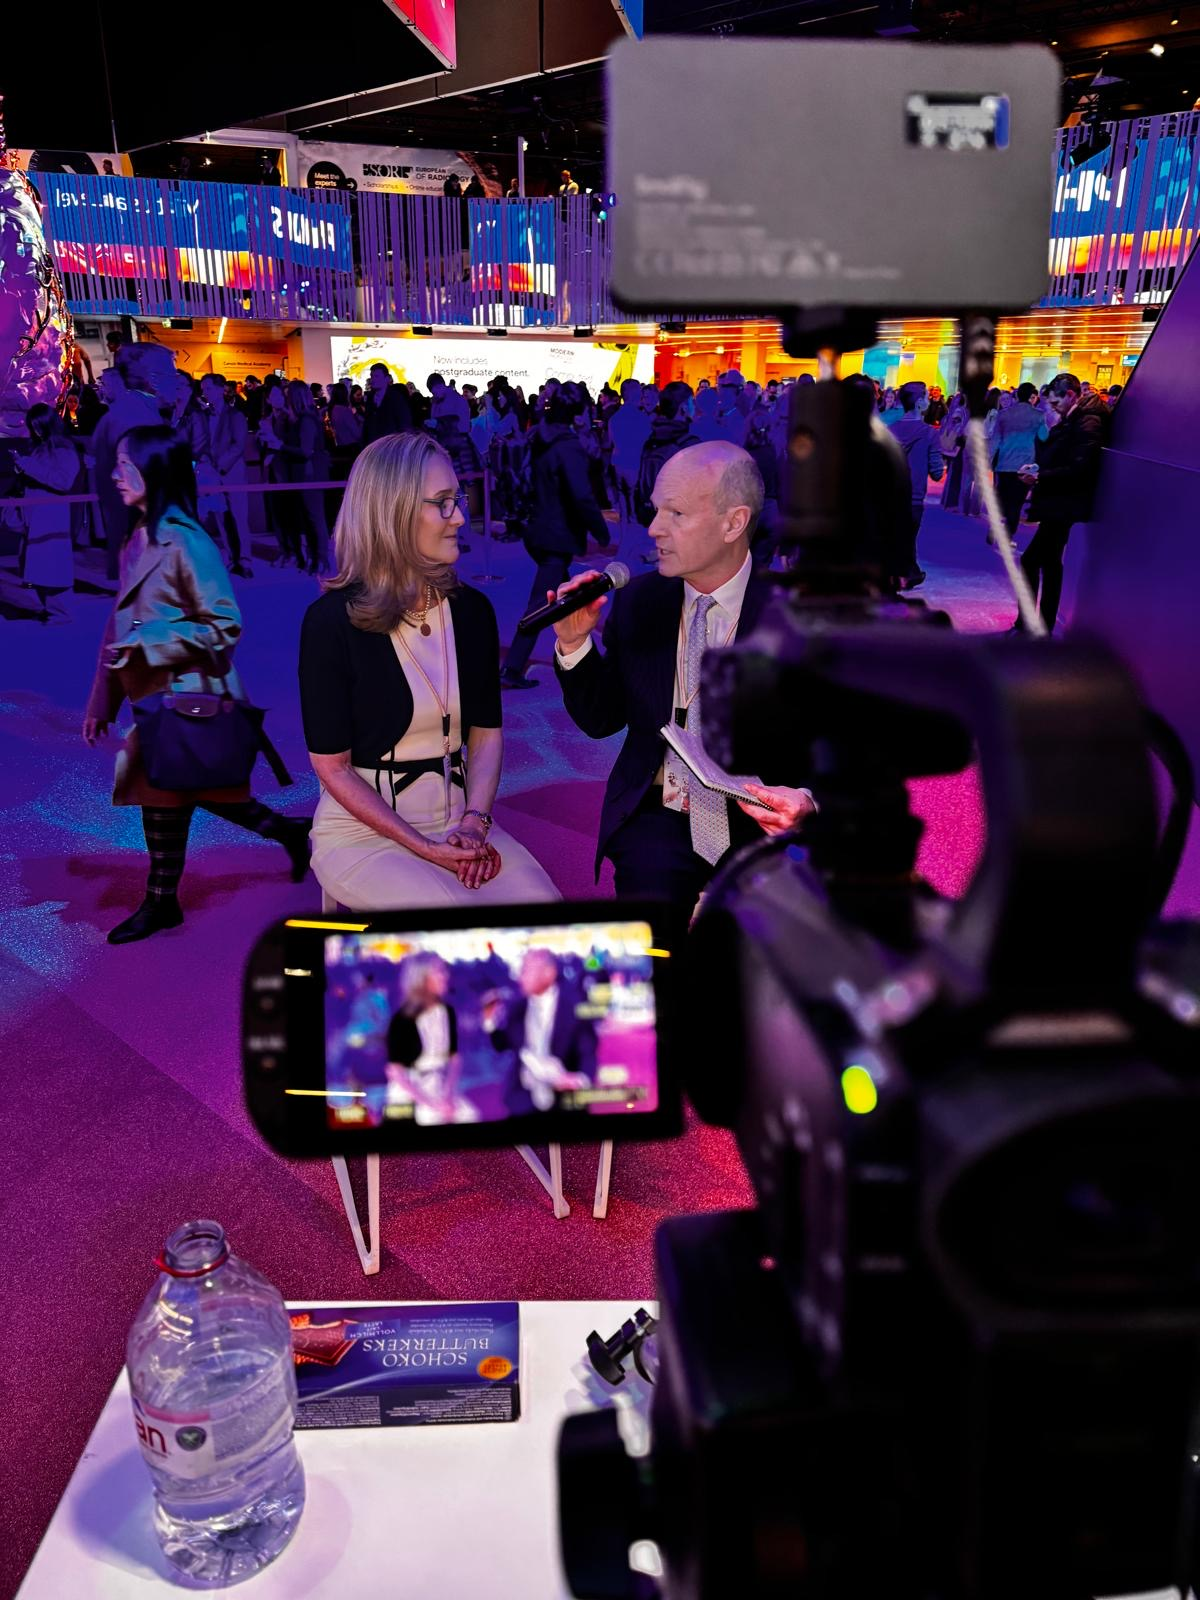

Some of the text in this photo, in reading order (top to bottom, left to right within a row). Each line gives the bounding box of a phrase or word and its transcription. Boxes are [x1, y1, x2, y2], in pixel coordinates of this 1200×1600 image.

[434, 355, 488, 365] Now includes
[434, 367, 493, 378] postgraduate
[350, 1328, 396, 1338] VOLLMILCH
[363, 1337, 489, 1352] BUTTERKEKS
[382, 1352, 468, 1367] SCHOKO
